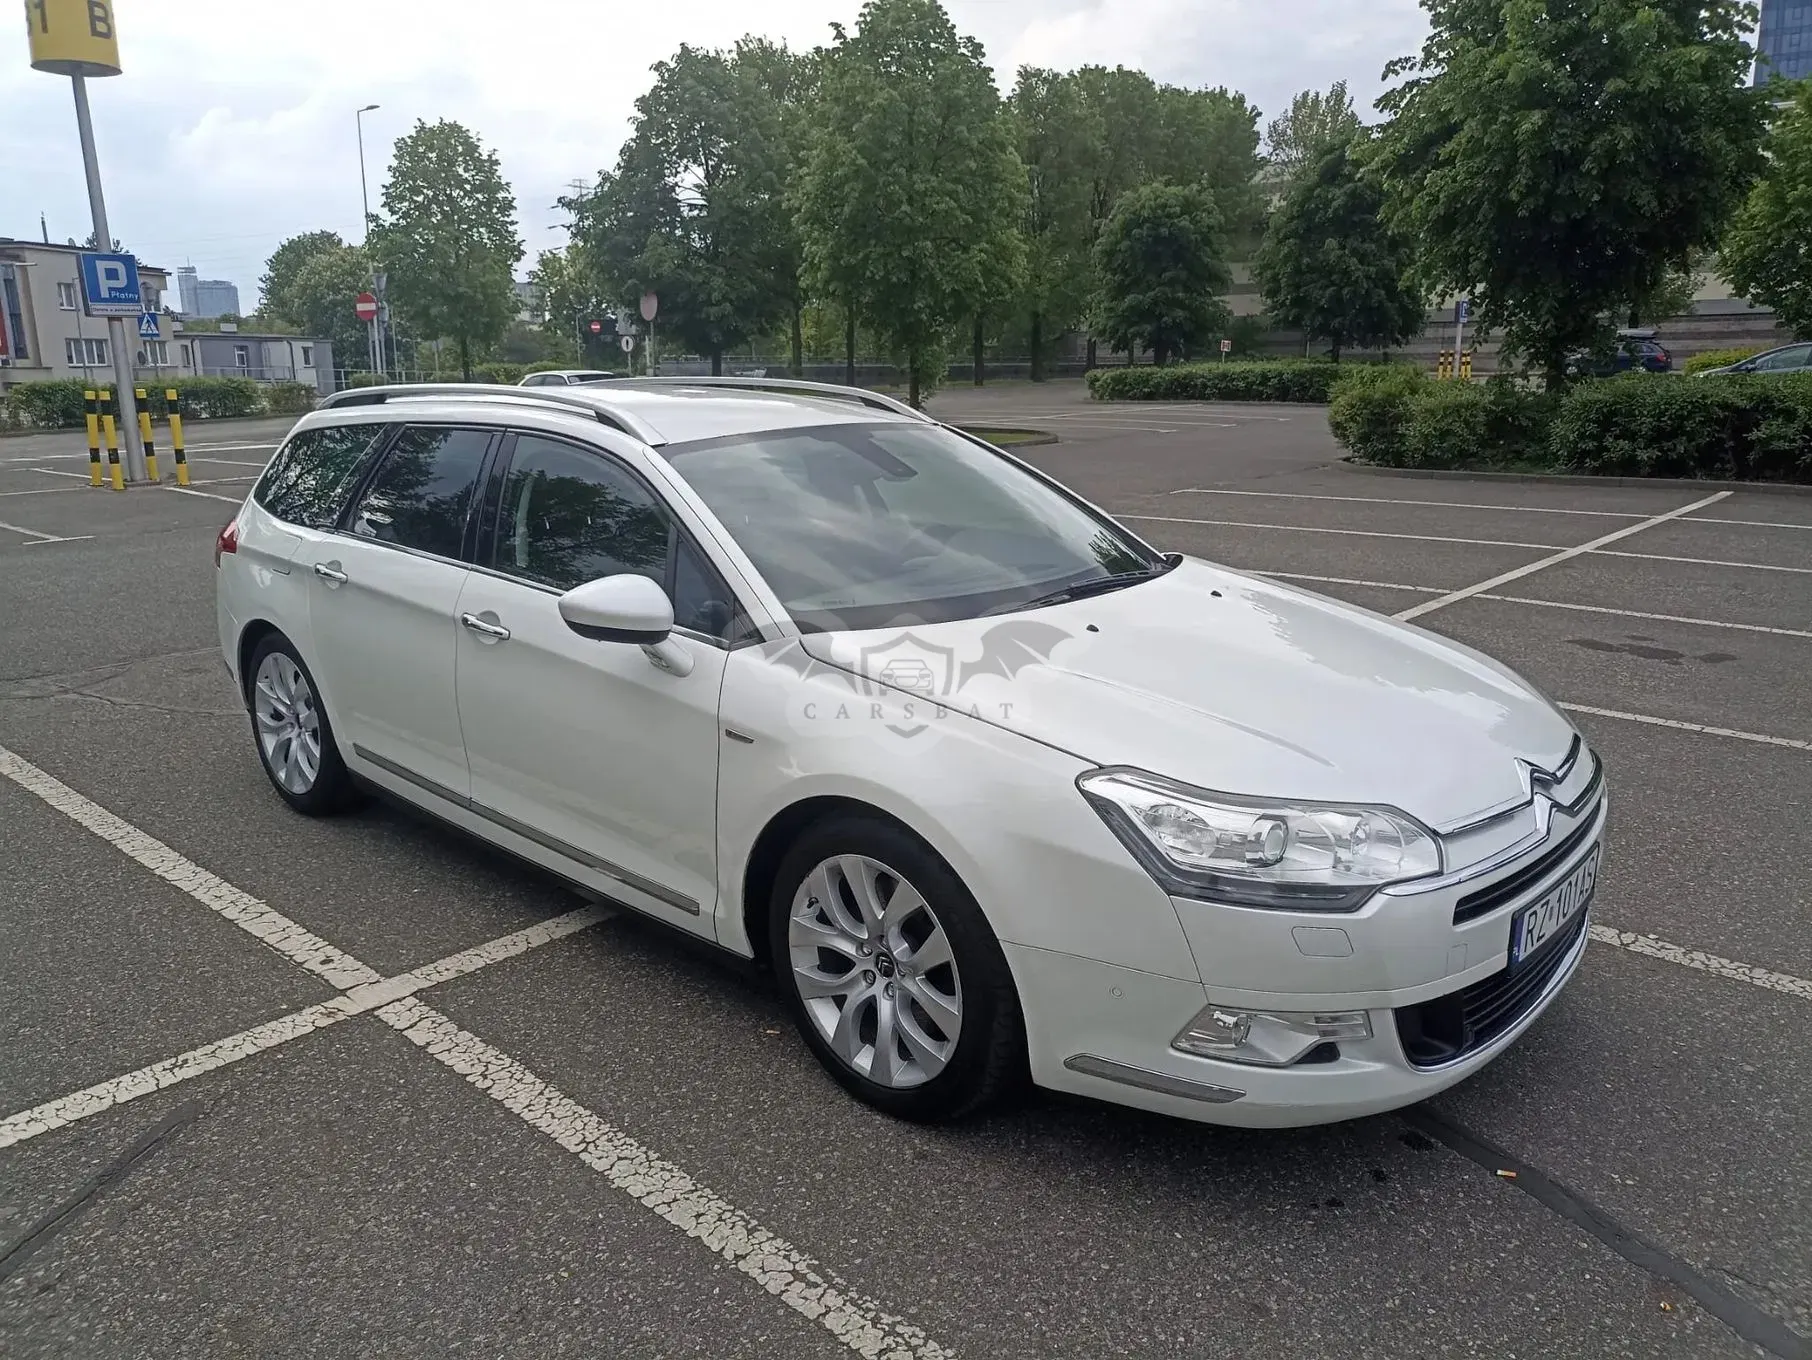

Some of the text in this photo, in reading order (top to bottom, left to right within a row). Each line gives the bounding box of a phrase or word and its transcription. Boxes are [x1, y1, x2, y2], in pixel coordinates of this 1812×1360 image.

[87, 0, 112, 39] B
[96, 260, 127, 298] P
[1524, 899, 1550, 952] RZ
